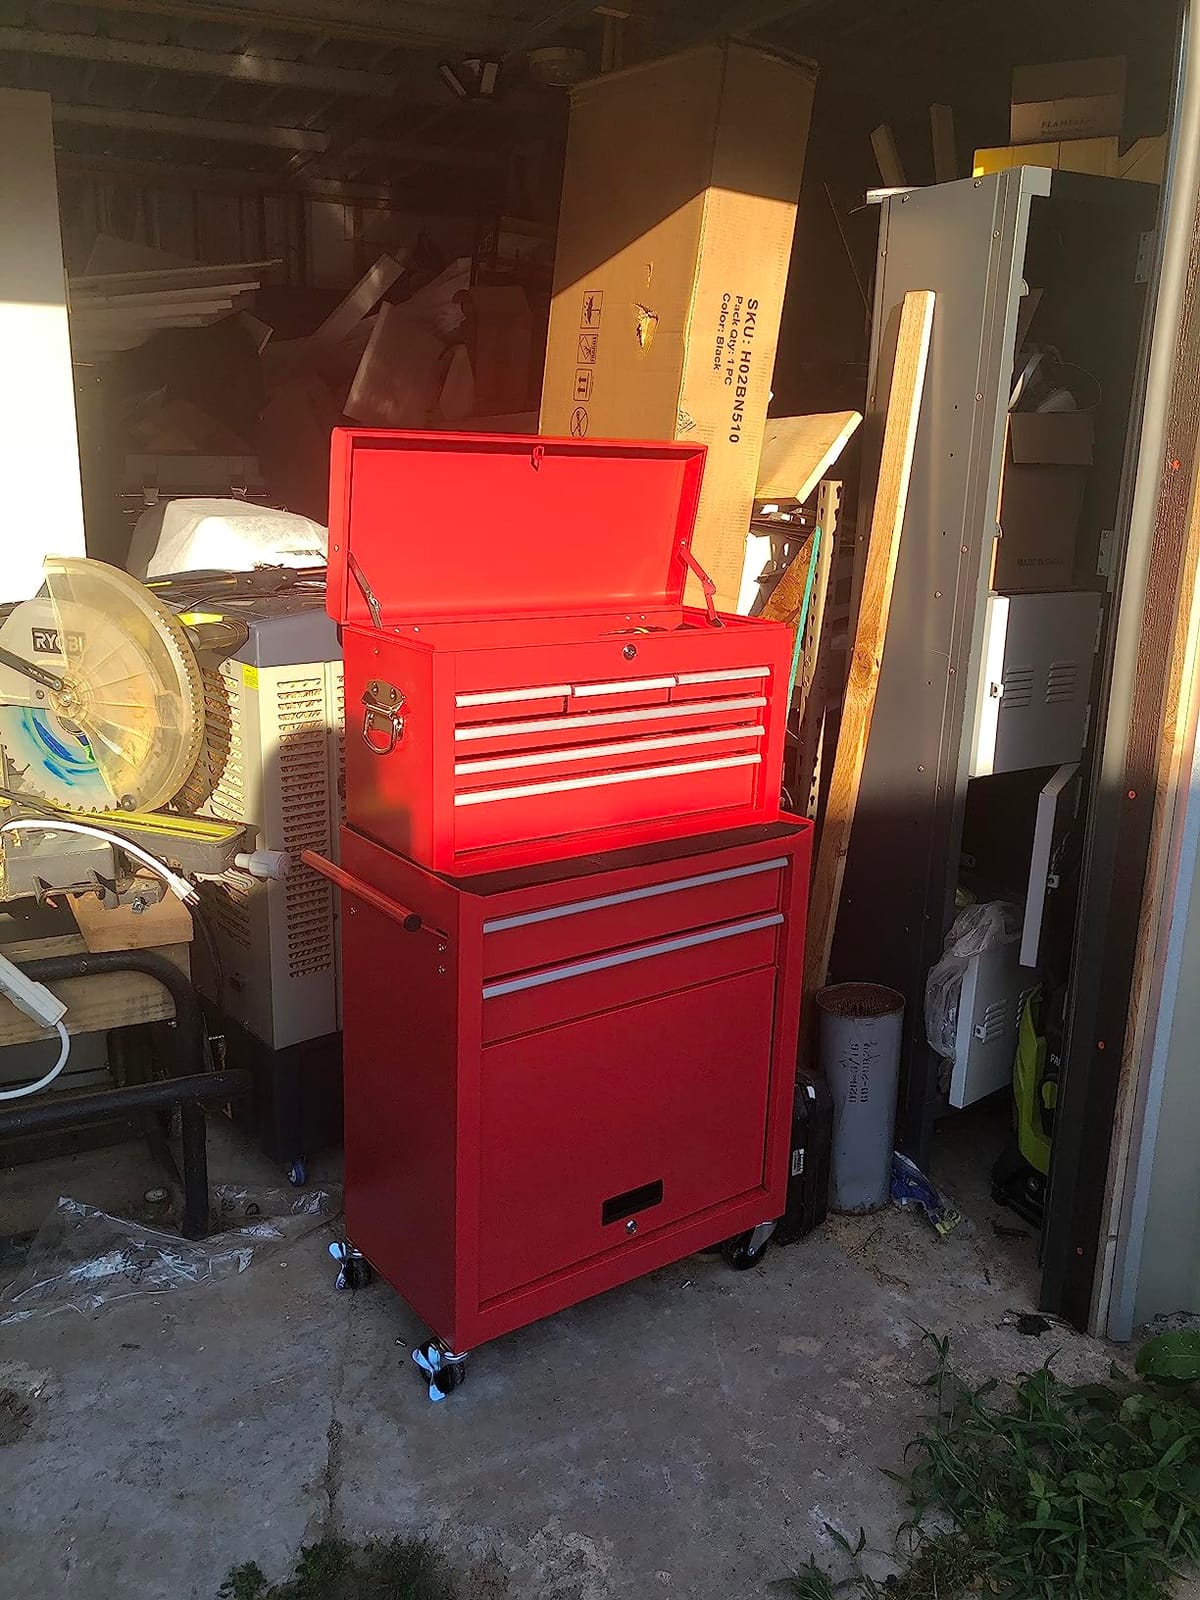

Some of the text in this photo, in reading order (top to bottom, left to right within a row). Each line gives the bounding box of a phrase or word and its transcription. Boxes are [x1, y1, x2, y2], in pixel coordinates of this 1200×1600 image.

[732, 295, 744, 326] Pack
[713, 292, 731, 371] Color: Black
[727, 329, 738, 354] Qty:
[724, 367, 734, 386] PC
[729, 298, 759, 443] SKU: H02BN510
